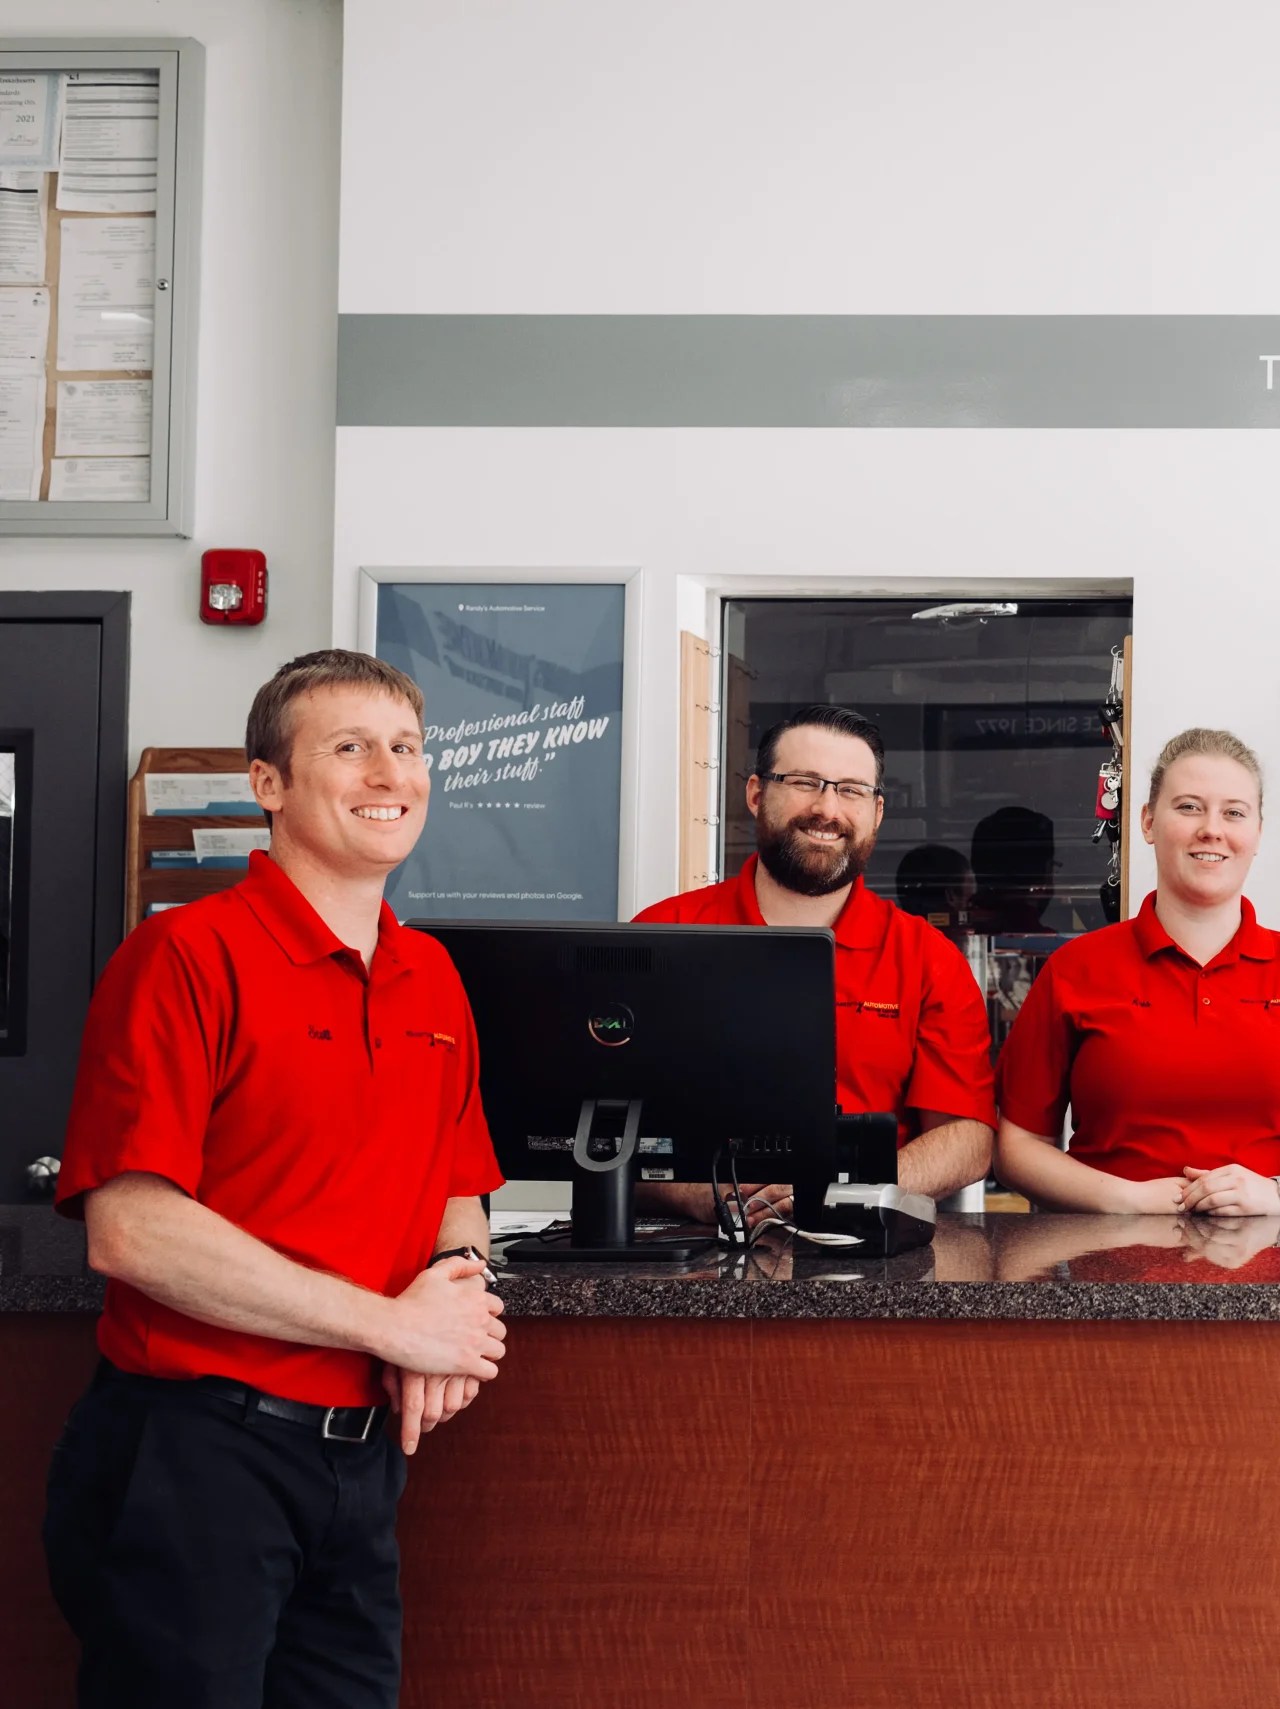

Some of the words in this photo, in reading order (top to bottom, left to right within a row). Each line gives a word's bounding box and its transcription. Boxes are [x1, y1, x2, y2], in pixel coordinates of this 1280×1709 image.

[15, 114, 36, 123] 2021
[424, 704, 541, 745] Professional
[541, 695, 586, 721] staff
[437, 742, 484, 771] BOY
[486, 730, 540, 761] THEY
[542, 716, 610, 750] KNOW
[443, 767, 494, 792] their
[408, 891, 436, 900] Support
[446, 891, 461, 899] with
[462, 893, 478, 901] your
[479, 892, 506, 900] reviews
[506, 891, 520, 900] and
[520, 891, 545, 901] photos
[863, 1000, 899, 1010] AUTOMOTIVE
